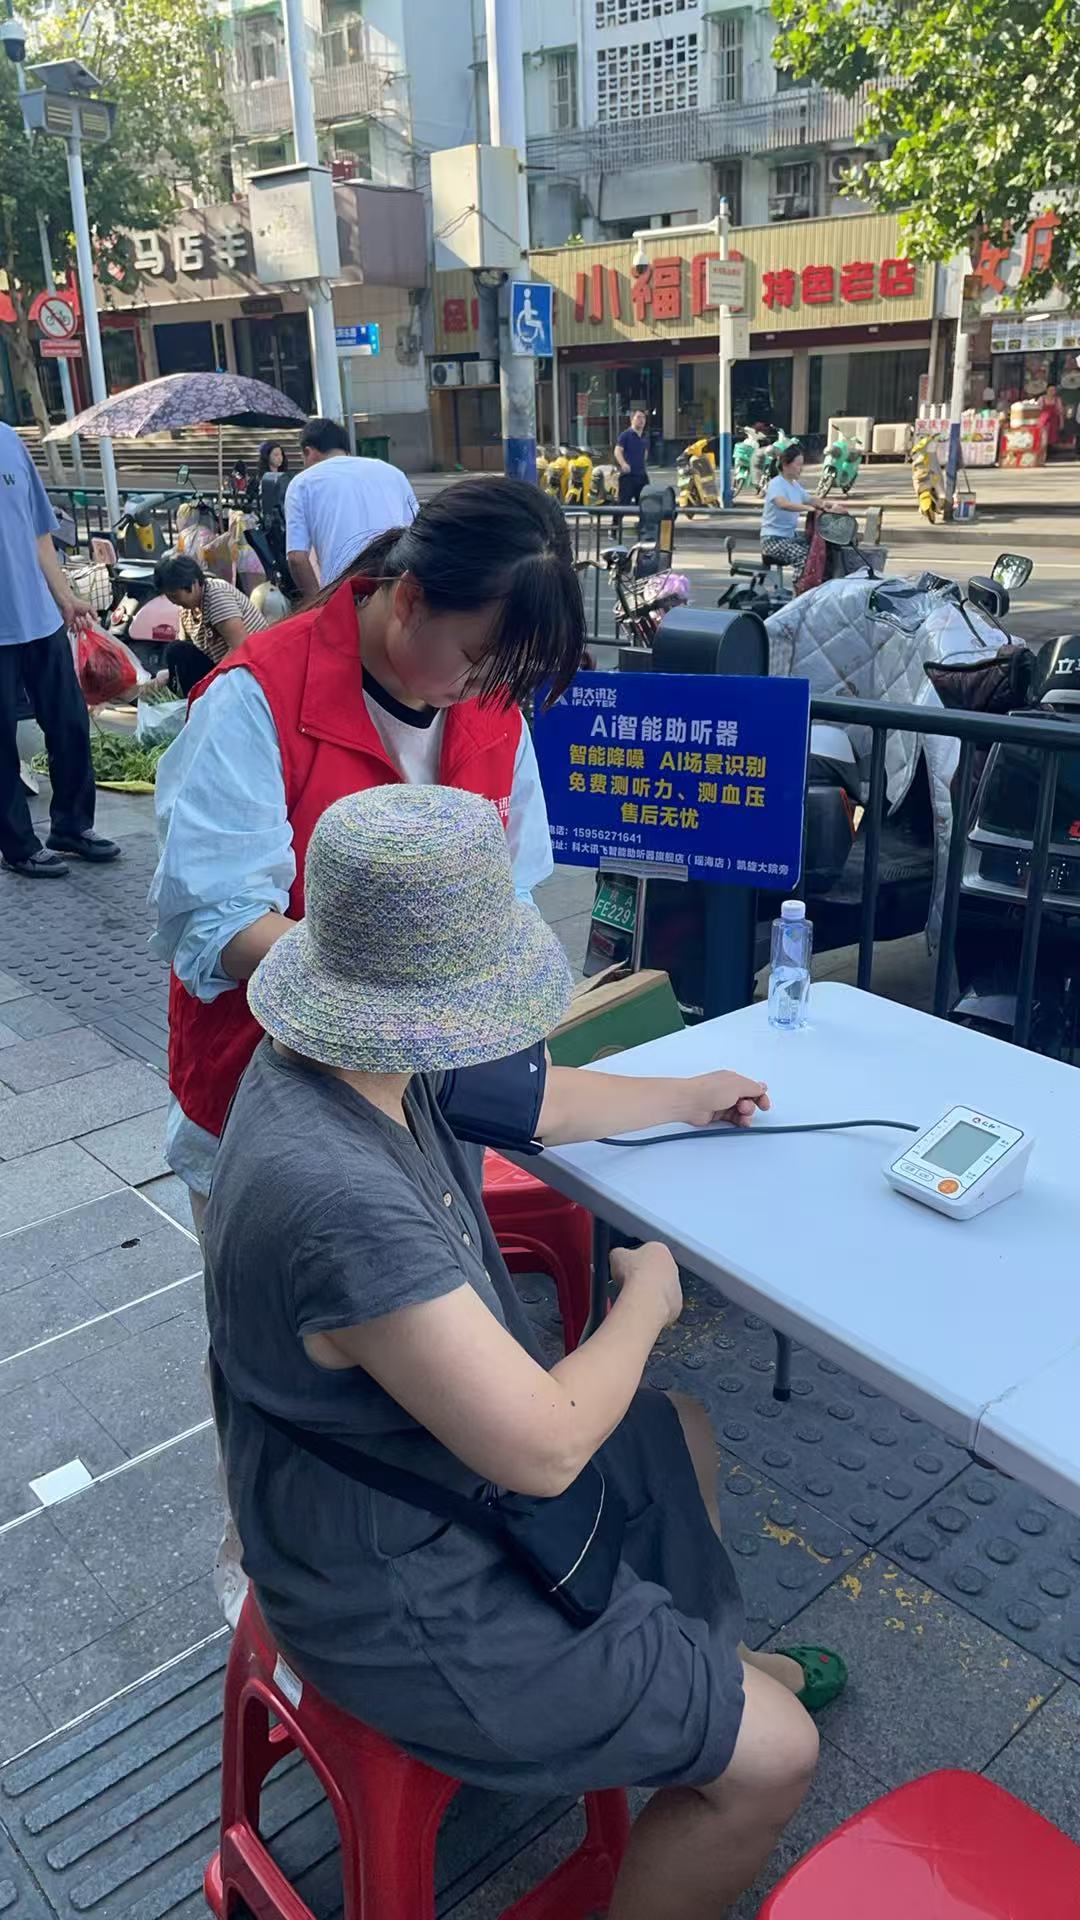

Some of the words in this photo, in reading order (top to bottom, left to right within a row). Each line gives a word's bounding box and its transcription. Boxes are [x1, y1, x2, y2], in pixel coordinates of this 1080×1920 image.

[762, 257, 915, 309] 特色老店
[572, 687, 617, 700] 科大讯飞
[590, 714, 738, 747] Ai智能助听器
[569, 744, 644, 769] 智能降噪
[659, 751, 766, 778] AI场景识别
[569, 772, 765, 807] 免费测听力、测血压
[620, 802, 699, 829] 售后无忧
